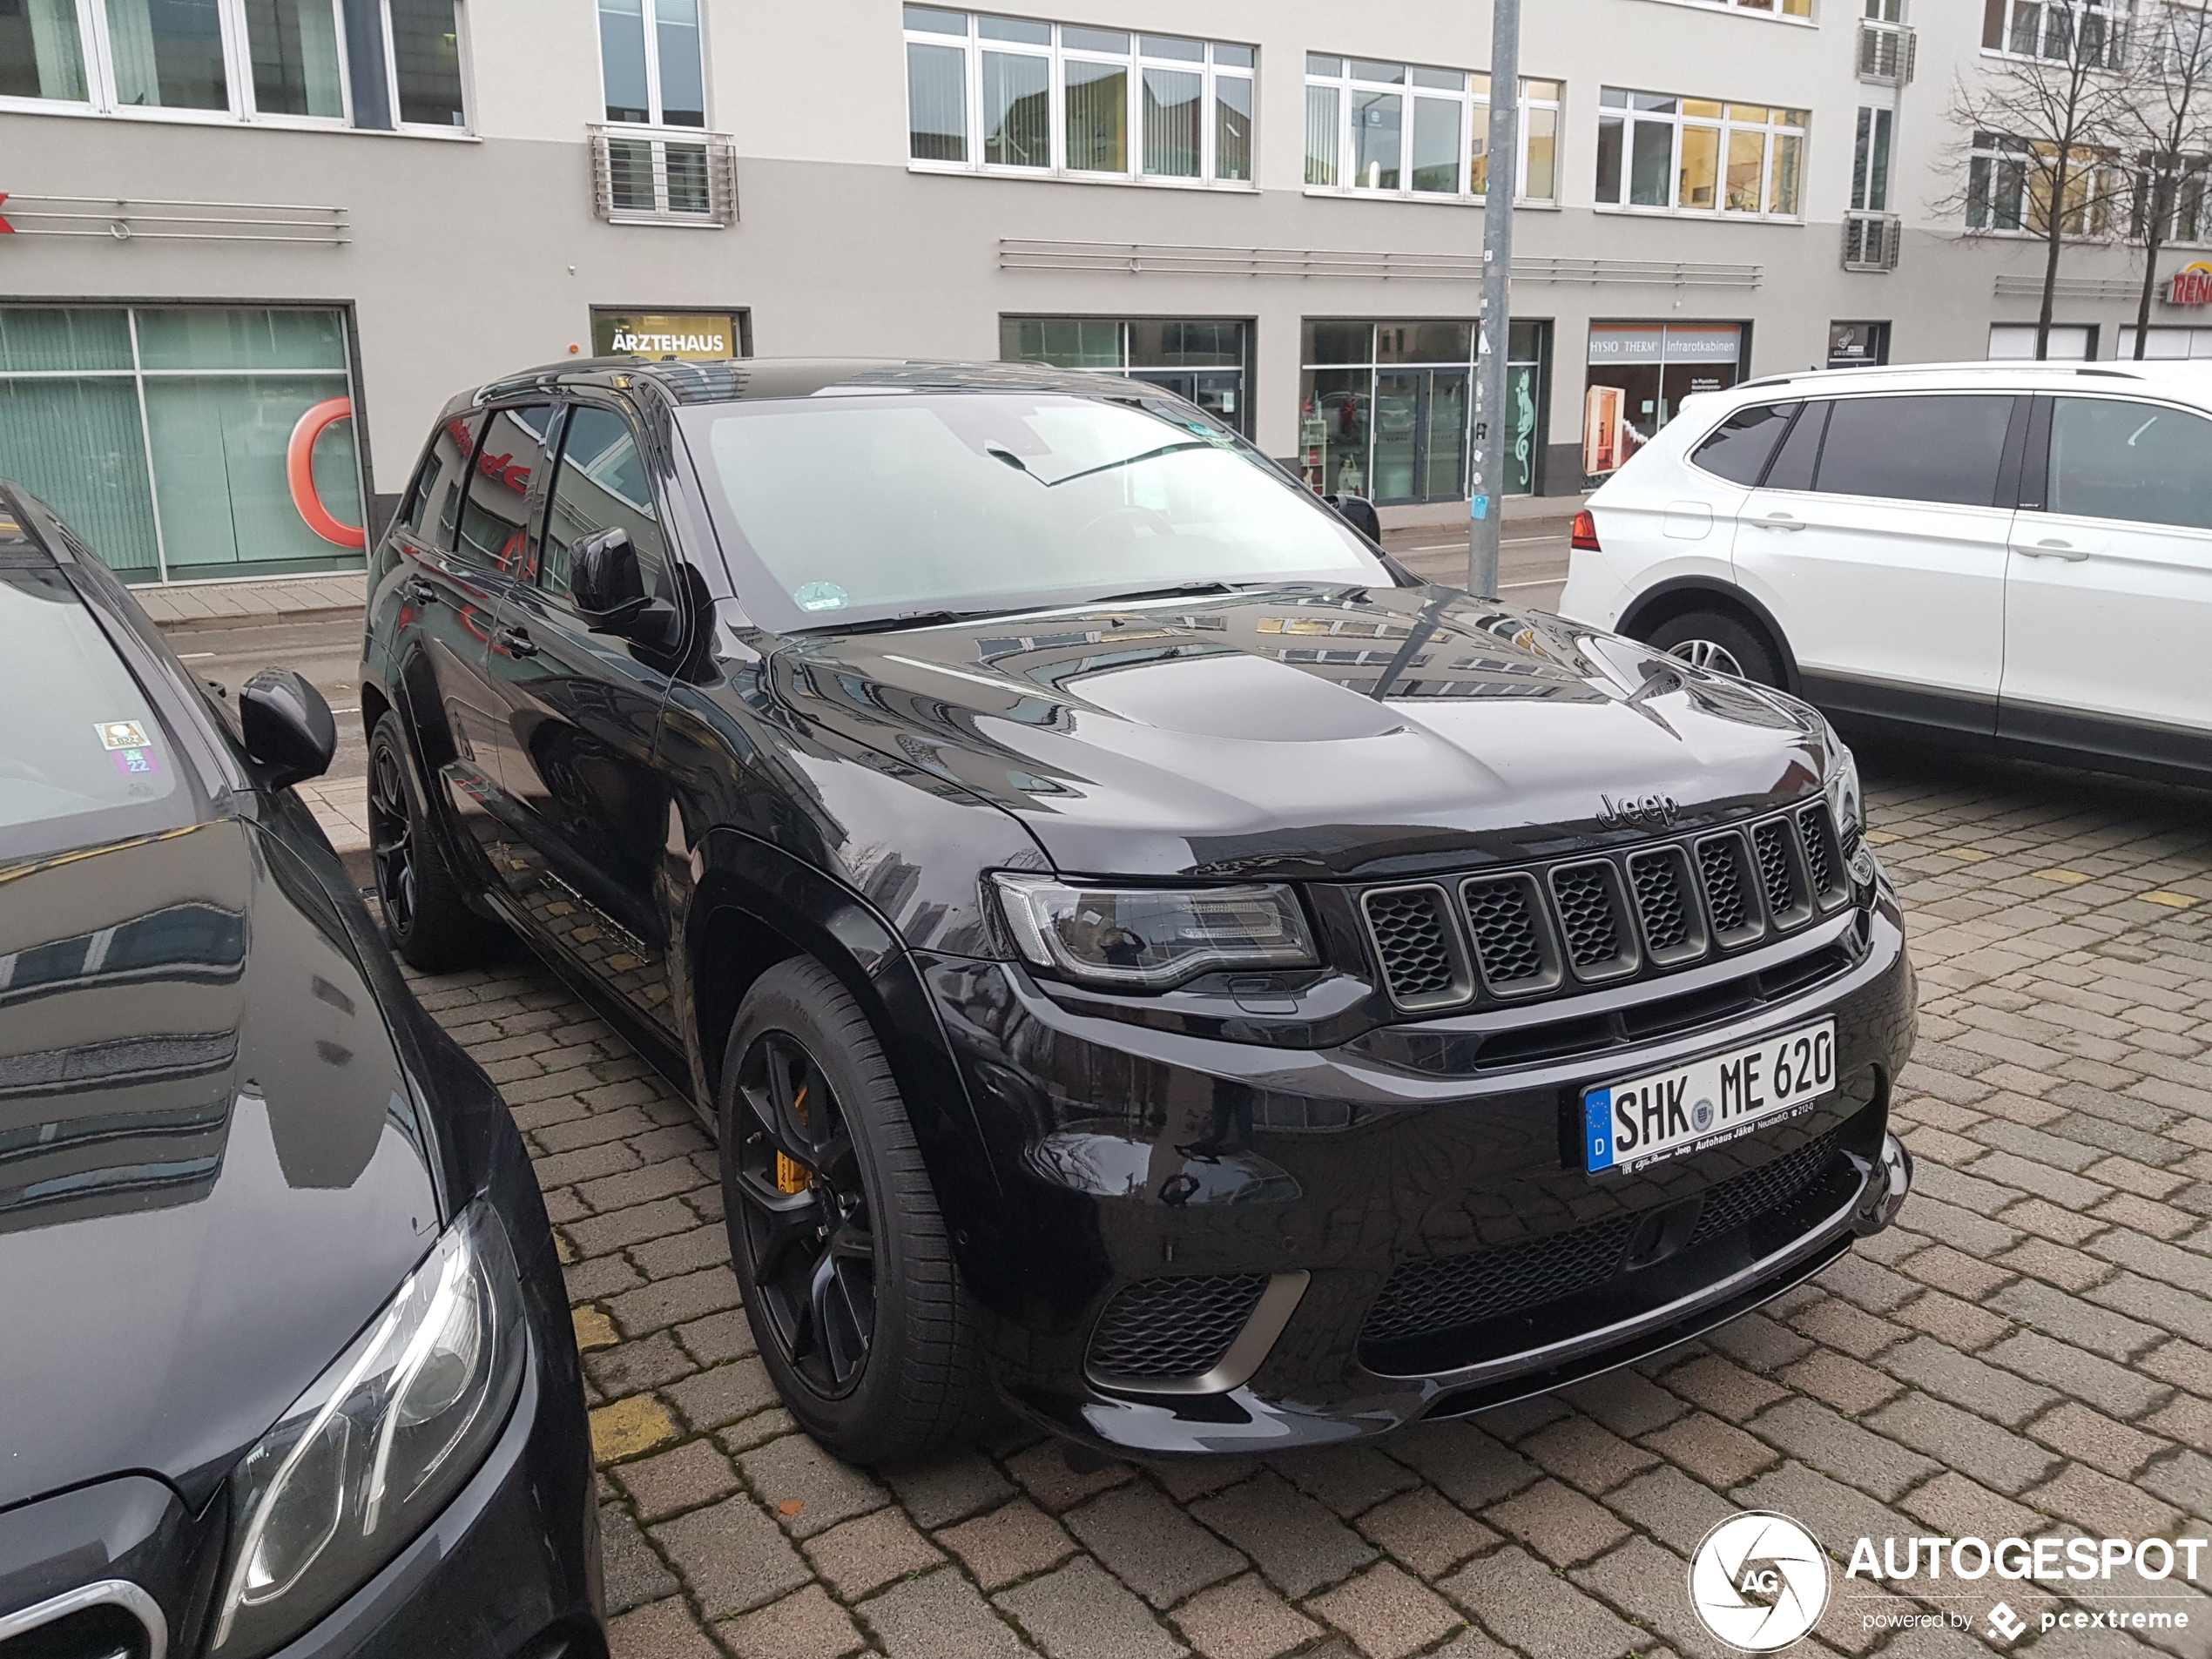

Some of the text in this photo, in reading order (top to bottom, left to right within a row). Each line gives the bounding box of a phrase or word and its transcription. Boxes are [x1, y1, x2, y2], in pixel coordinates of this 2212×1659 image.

[611, 329, 724, 351] ÄRZTEHAUS
[1667, 341, 1735, 352] Infrarotkabinen
[127, 759, 150, 772] 22
[1596, 792, 1682, 828] Jeep
[1595, 1029, 1831, 1156] D SHK ME 620
[1675, 1144, 1691, 1157] Jeep
[1696, 1132, 1732, 1151] Autohaus
[1733, 1121, 1755, 1138] Jäkel
[1797, 1102, 1814, 1116] 212-0
